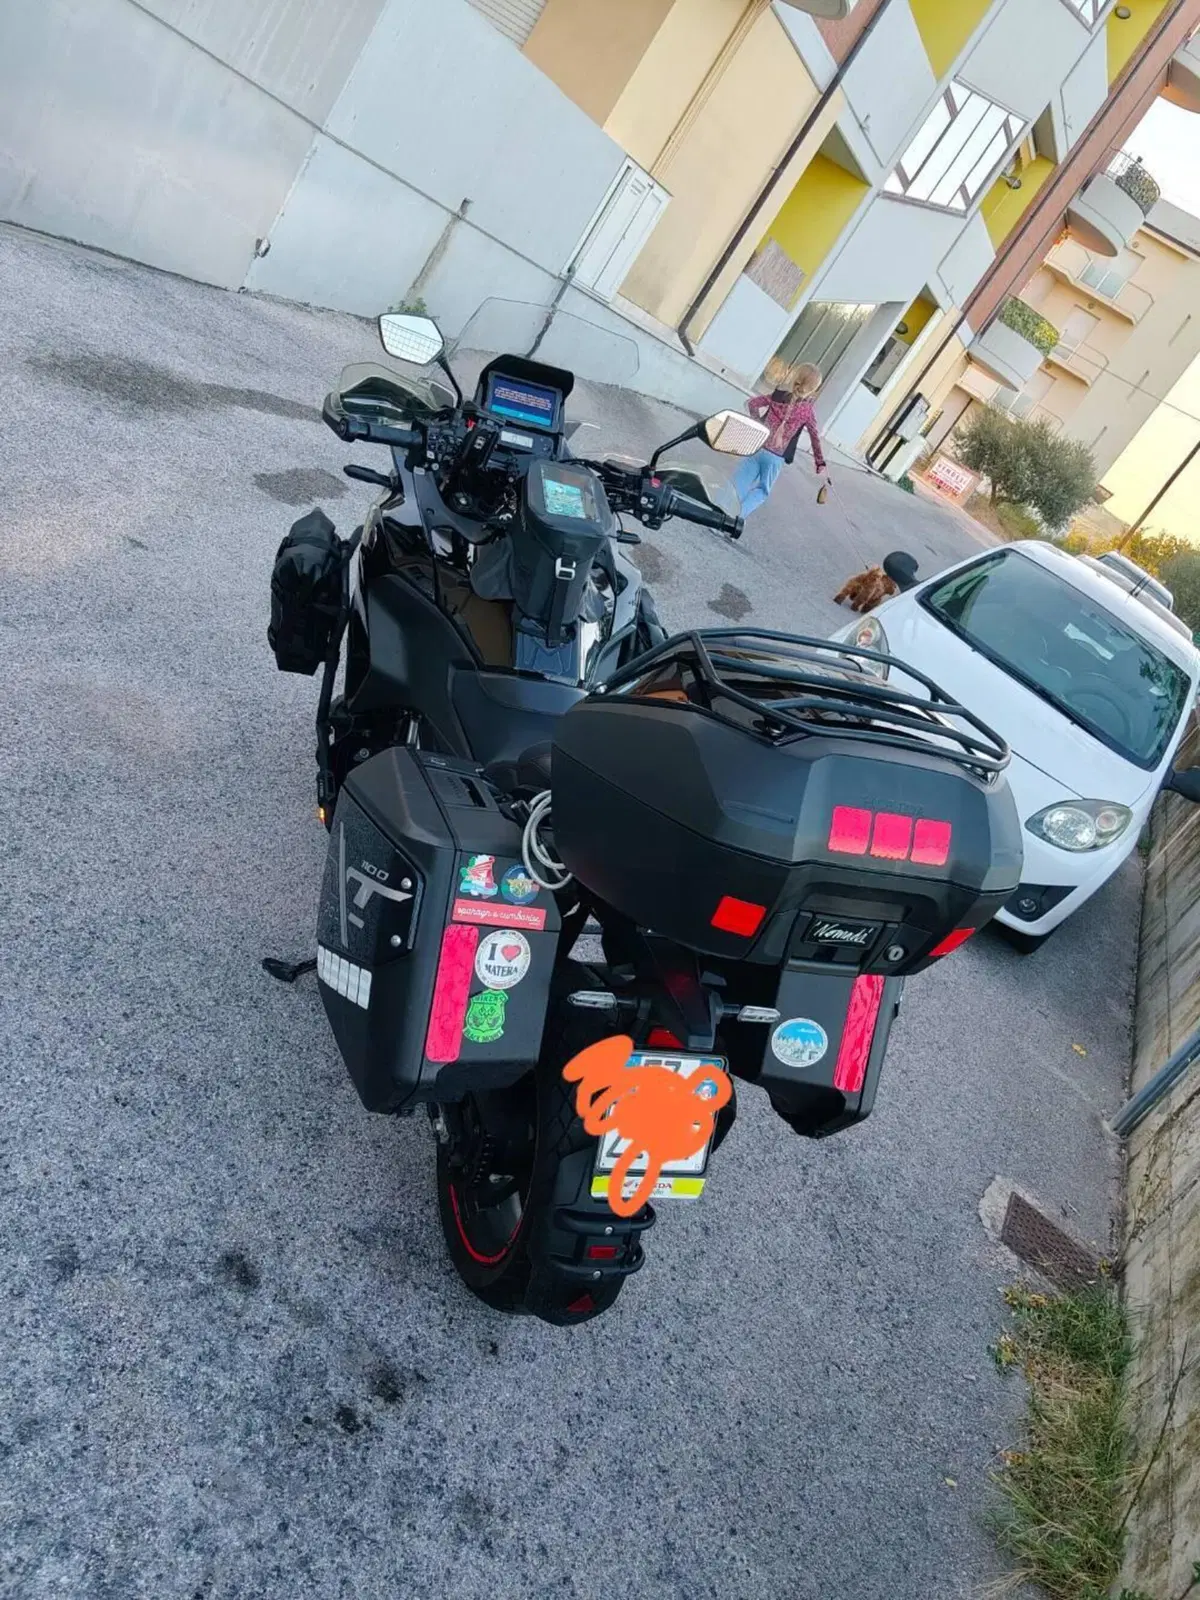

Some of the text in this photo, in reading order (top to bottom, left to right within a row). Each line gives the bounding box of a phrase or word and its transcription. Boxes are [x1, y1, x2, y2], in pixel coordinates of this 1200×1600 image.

[361, 859, 390, 881] 1100
[487, 942, 498, 961] I
[484, 963, 519, 978] MATERA
